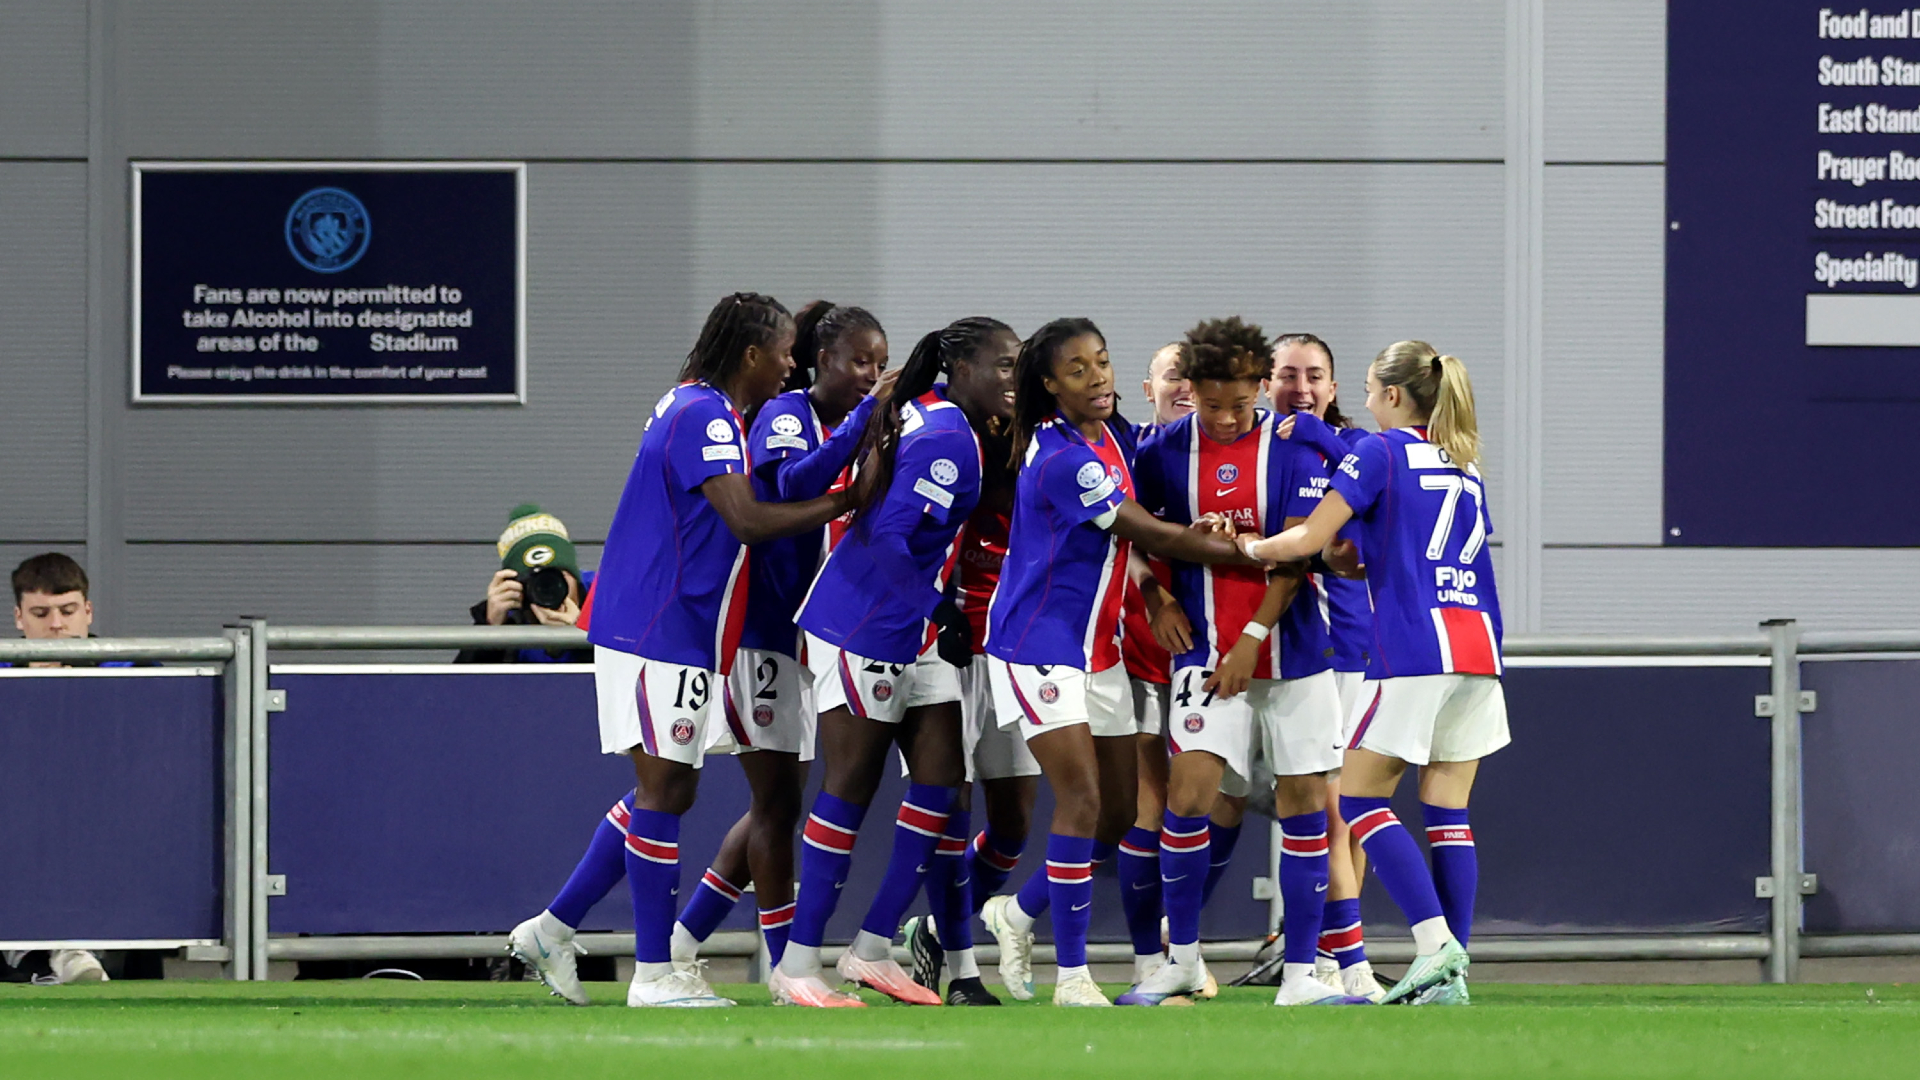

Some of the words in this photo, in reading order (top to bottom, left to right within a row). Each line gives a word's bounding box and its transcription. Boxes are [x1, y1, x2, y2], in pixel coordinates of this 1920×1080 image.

[1818, 8, 1868, 39] Food
[1870, 8, 1910, 39] and
[1817, 55, 1880, 86] South
[1817, 103, 1864, 134] East
[1817, 150, 1888, 187] Prayer
[1814, 198, 1879, 229] Street
[1814, 251, 1919, 289] Speciality
[193, 285, 244, 304] Fans
[245, 288, 281, 304] are
[283, 288, 331, 304] now
[332, 284, 437, 307] permitted
[438, 286, 462, 304] to
[182, 309, 229, 328] take
[231, 308, 311, 328] Alcohol
[313, 308, 354, 328] into
[356, 308, 473, 332] designated
[196, 336, 256, 352] areas
[258, 332, 281, 352] of
[284, 332, 319, 352] the
[370, 332, 459, 352] Stadium
[254, 366, 278, 379] the
[278, 366, 313, 379] drink
[314, 366, 328, 379] in
[329, 366, 352, 379] the
[408, 366, 423, 379] of
[424, 366, 456, 382] your
[1219, 507, 1254, 520] ATAR
[1419, 474, 1486, 565] 77
[673, 667, 709, 712] 19
[754, 657, 779, 700] 2
[1174, 669, 1216, 708] 47
